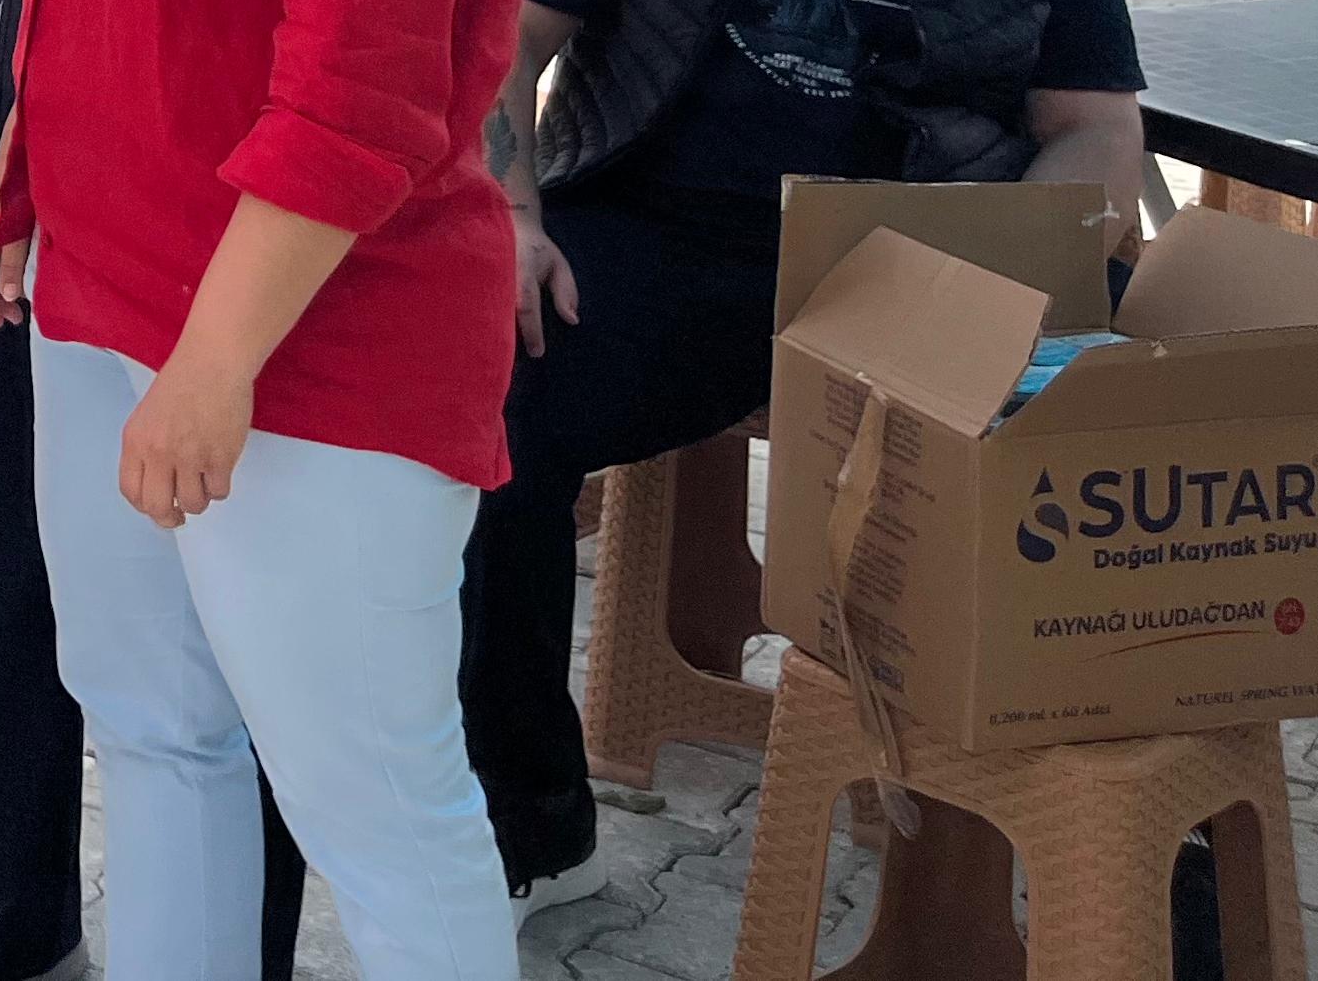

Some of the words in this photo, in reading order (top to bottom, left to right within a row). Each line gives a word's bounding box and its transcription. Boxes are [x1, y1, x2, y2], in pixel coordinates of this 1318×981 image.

[1078, 464, 1317, 538] SUTAR
[1093, 542, 1163, 570] Doğal
[1170, 535, 1257, 564] Kaynak
[1264, 529, 1318, 556] Suyu
[1033, 610, 1126, 639] KAYNAĞI
